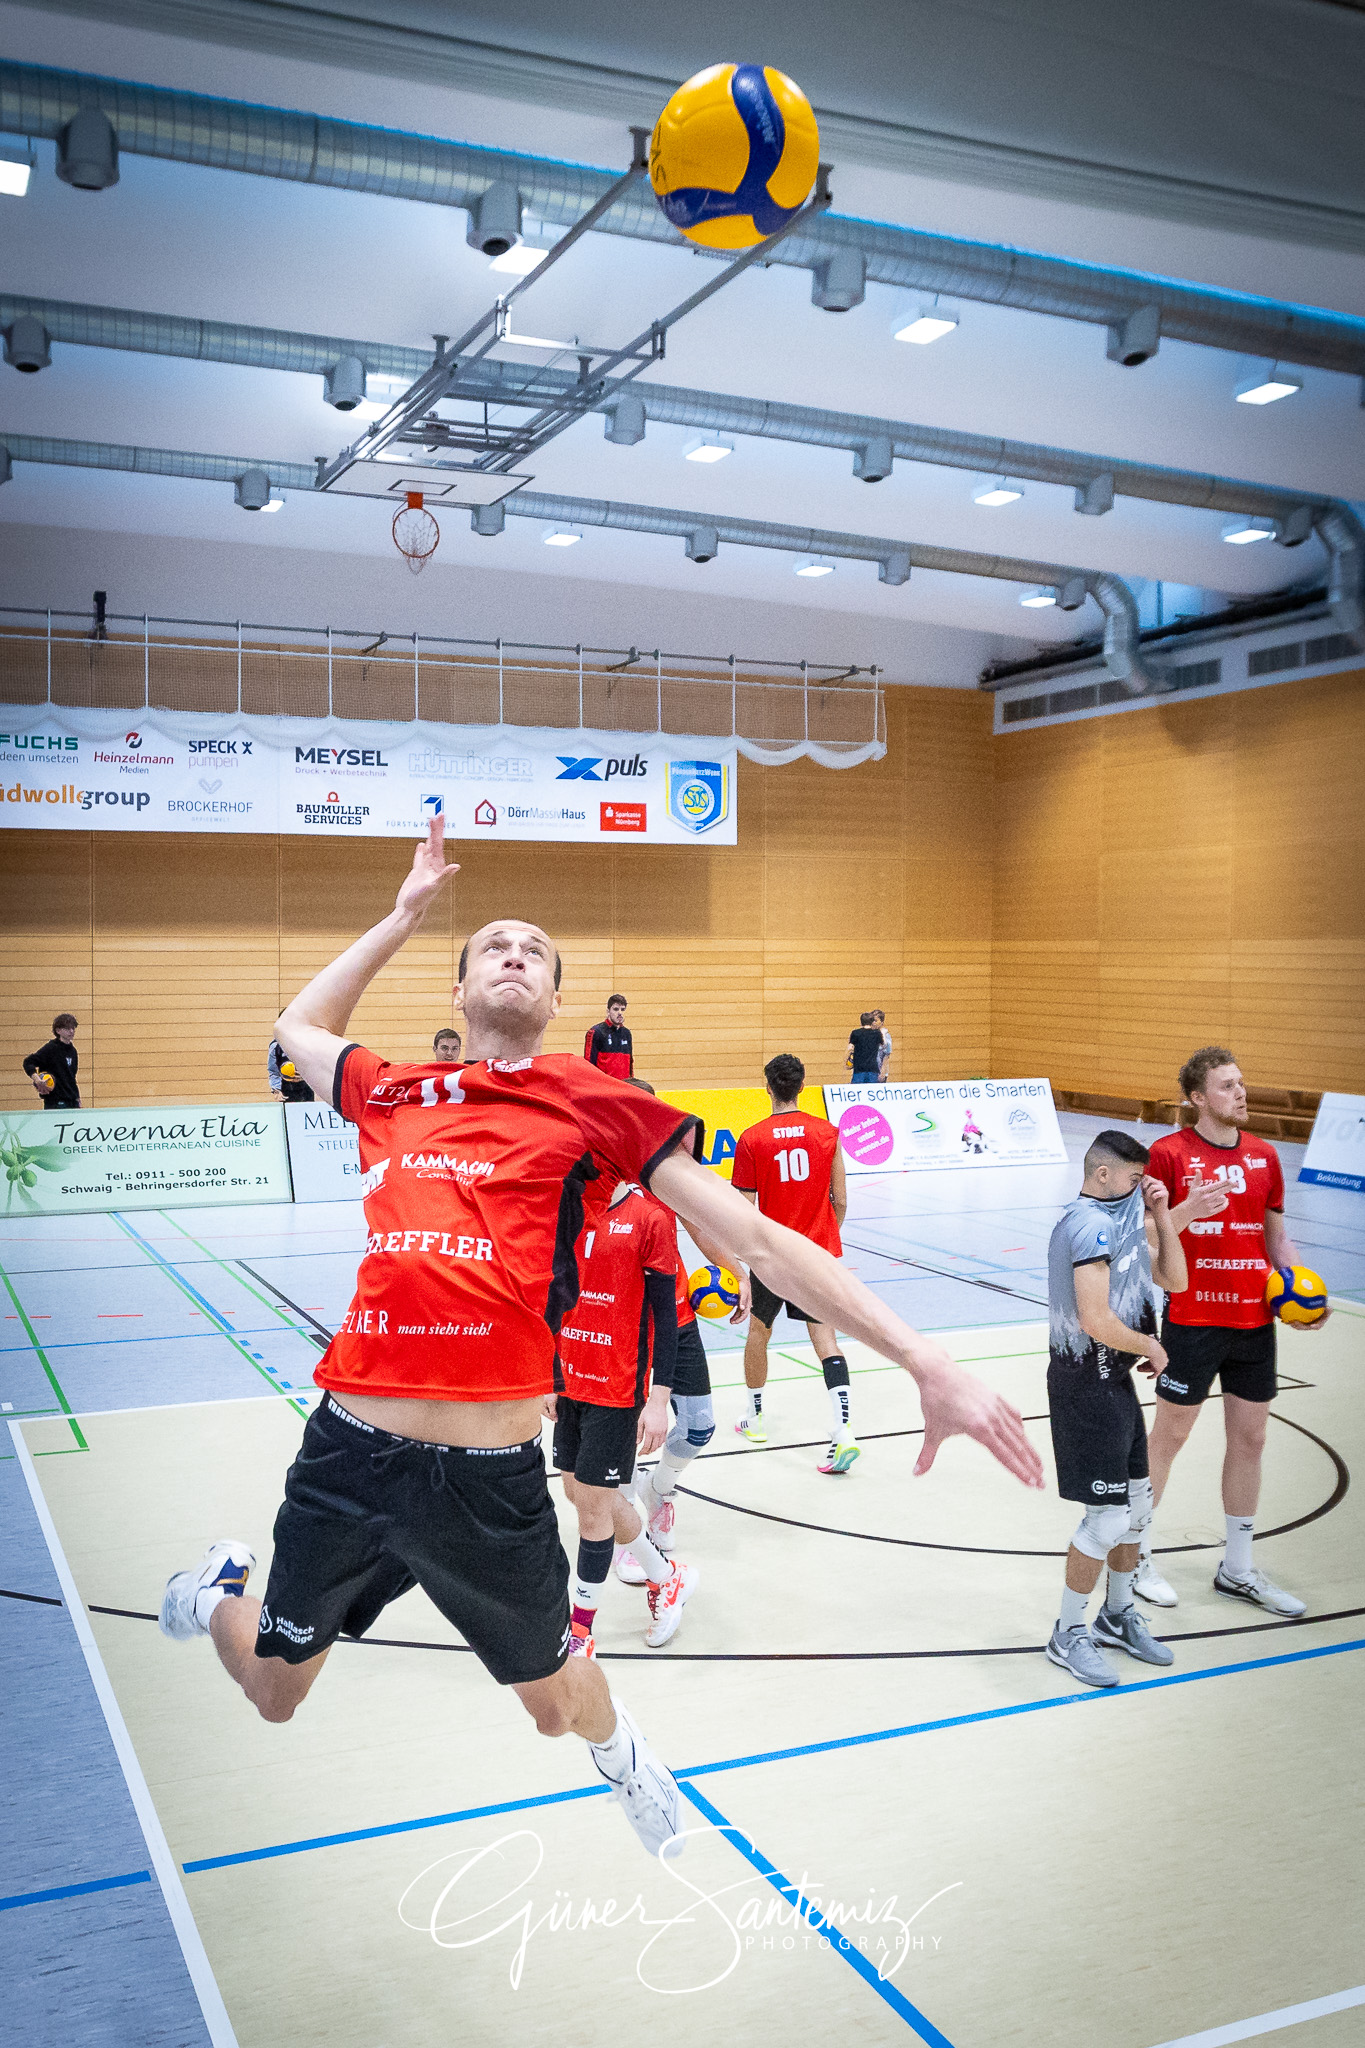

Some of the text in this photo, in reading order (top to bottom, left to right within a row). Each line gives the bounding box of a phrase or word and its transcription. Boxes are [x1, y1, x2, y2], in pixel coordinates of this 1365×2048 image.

[0, 734, 79, 750] FUCHS
[188, 740, 237, 754] SPECK
[28, 752, 79, 764] umsetzen
[94, 751, 174, 765] Heinzelmann
[188, 755, 239, 769] pumpen
[295, 747, 388, 767] MEYSEL
[119, 765, 149, 774] Medien
[295, 766, 320, 774] Druck
[330, 769, 388, 777] Werbetechnik
[168, 800, 253, 813] BROCKERHOF
[508, 806, 586, 820] DörrMassivHaus
[304, 815, 362, 825] SERVICES
[386, 820, 411, 828] FÜRST
[830, 1082, 1047, 1102] Hier schnarchen die Smarten
[54, 1115, 268, 1144] Taverna Elia
[772, 1126, 805, 1139] STORZ
[842, 1116, 880, 1138] Mehr Infos
[857, 1129, 876, 1143] unter
[63, 1139, 261, 1154] GREEK MEDITERRANEAN CUISINE
[401, 1153, 495, 1176] KAMMACHI
[773, 1148, 810, 1182] 10
[105, 1172, 132, 1181] Tel.:
[136, 1170, 165, 1179] 0911
[178, 1169, 201, 1178] 500
[205, 1168, 226, 1177] 200
[1213, 1164, 1247, 1194] 18
[1316, 1172, 1362, 1189] Bekleidung
[61, 1184, 113, 1194] Schwaig
[125, 1178, 227, 1192] Behringersdorfer
[231, 1177, 251, 1186] Str.
[255, 1176, 269, 1185] 21
[1195, 1290, 1240, 1304] DELKER
[397, 1324, 426, 1335] man
[429, 1322, 460, 1335] sieht
[462, 1322, 493, 1336] sich!
[276, 1616, 315, 1635] Hallasch
[275, 1625, 314, 1645] Aufzüge
